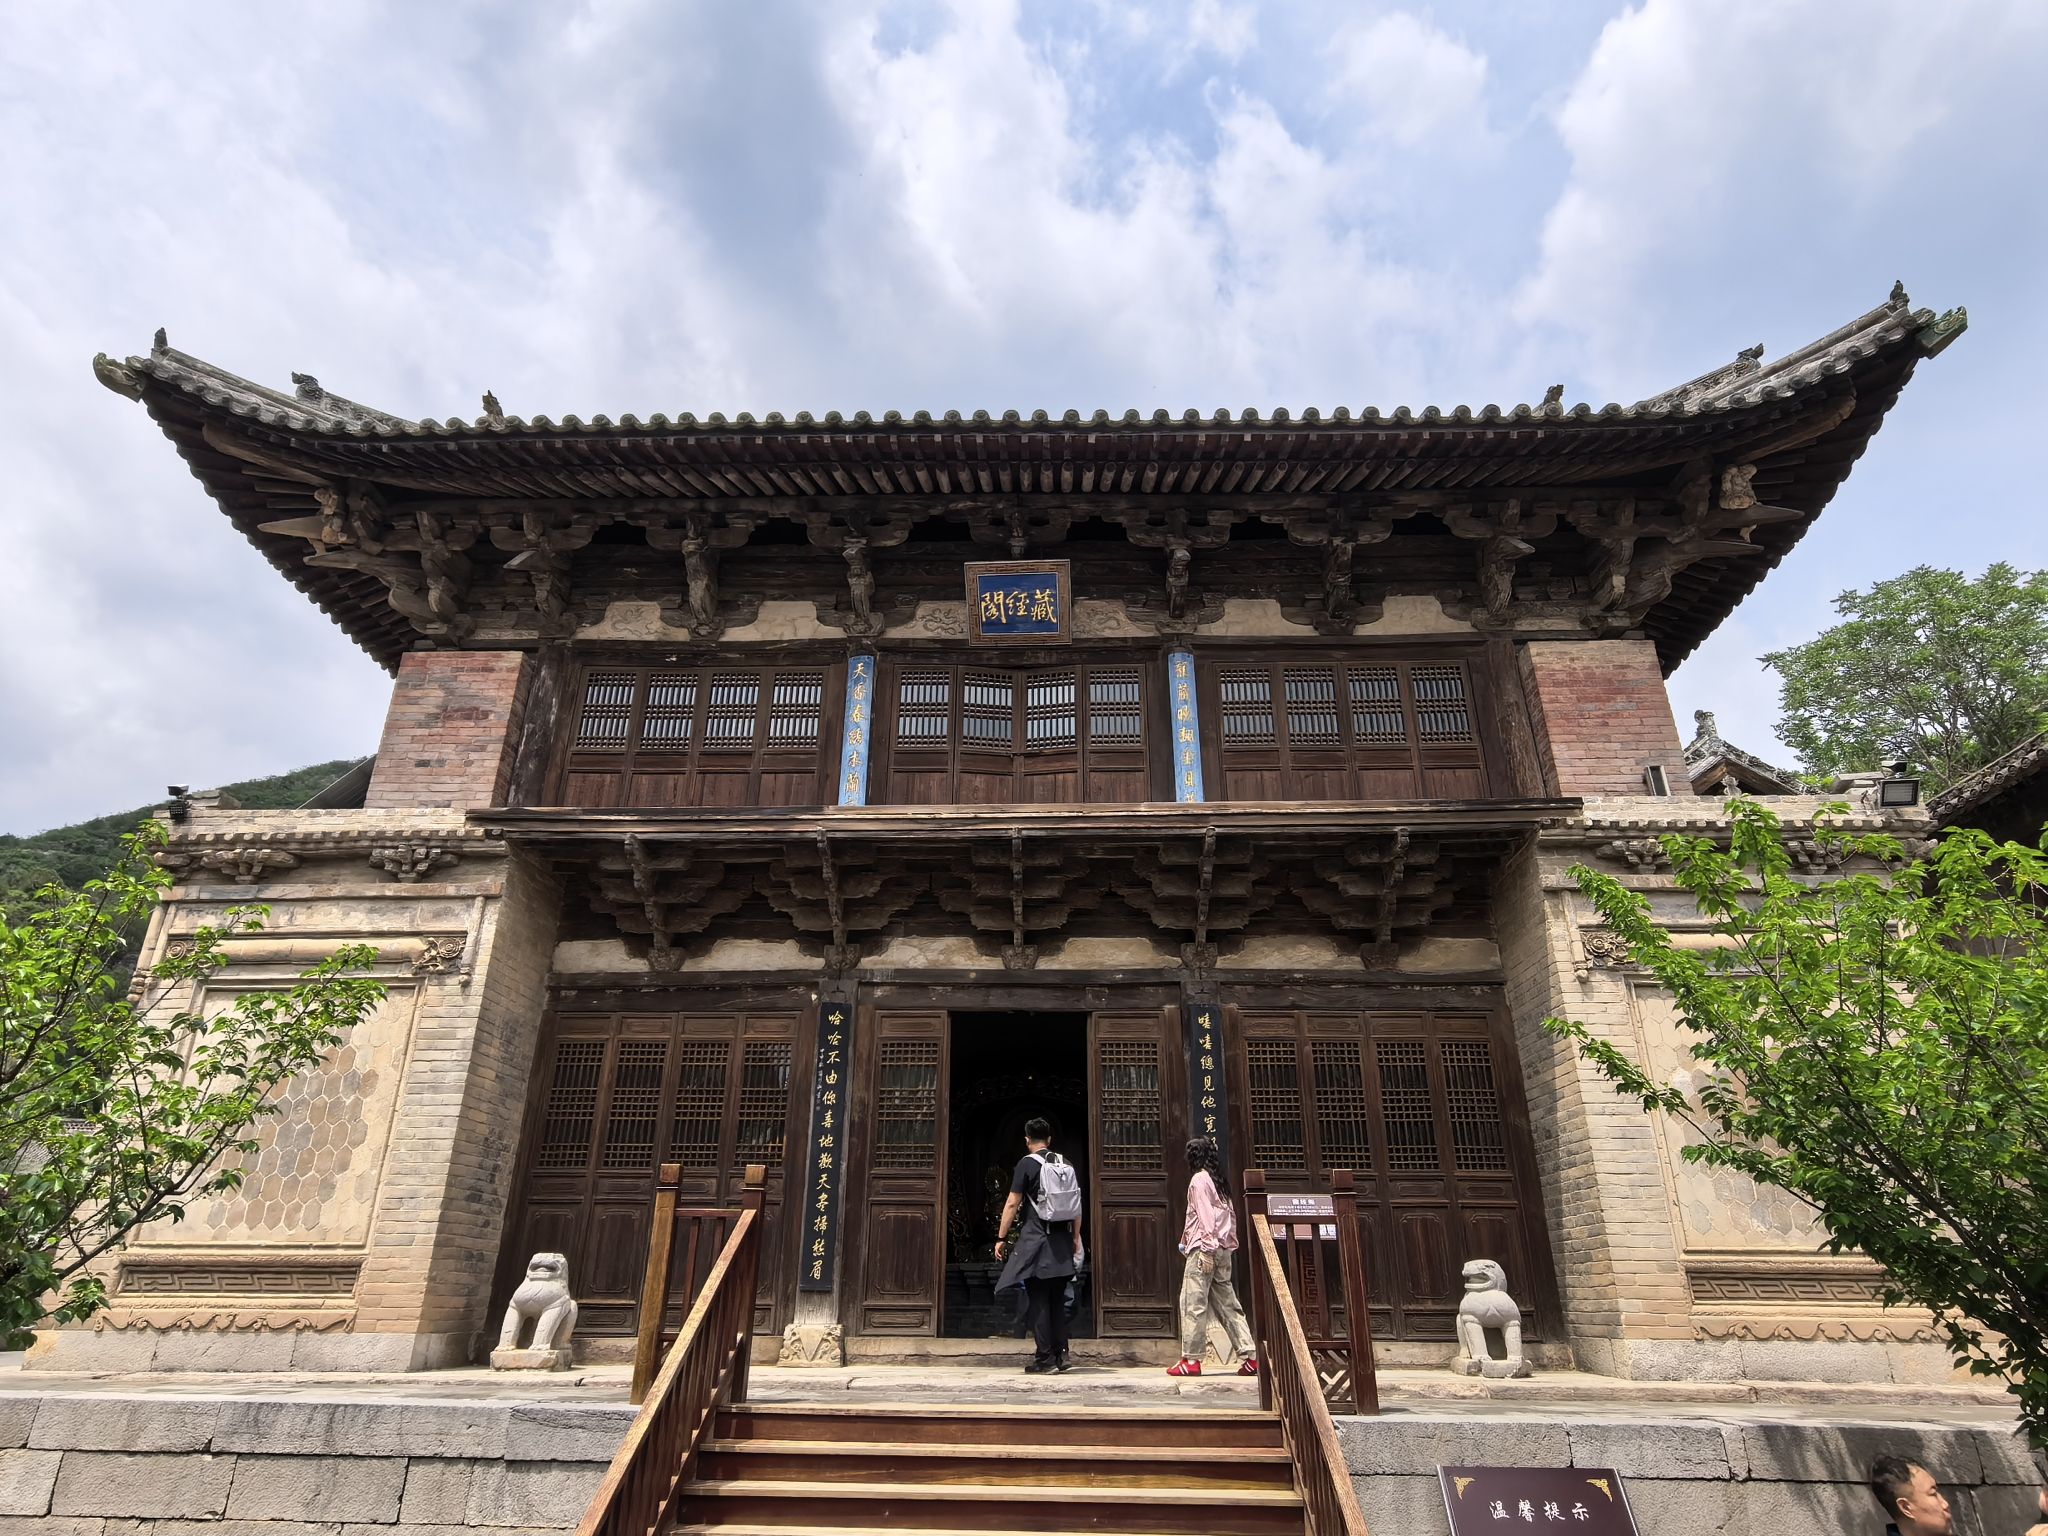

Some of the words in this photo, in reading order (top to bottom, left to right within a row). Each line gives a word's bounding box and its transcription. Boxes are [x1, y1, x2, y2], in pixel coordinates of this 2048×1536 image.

[1198, 1012, 1219, 1151] 嘻嘻總見他寬
[1489, 1499, 1591, 1523] 温馨提示
